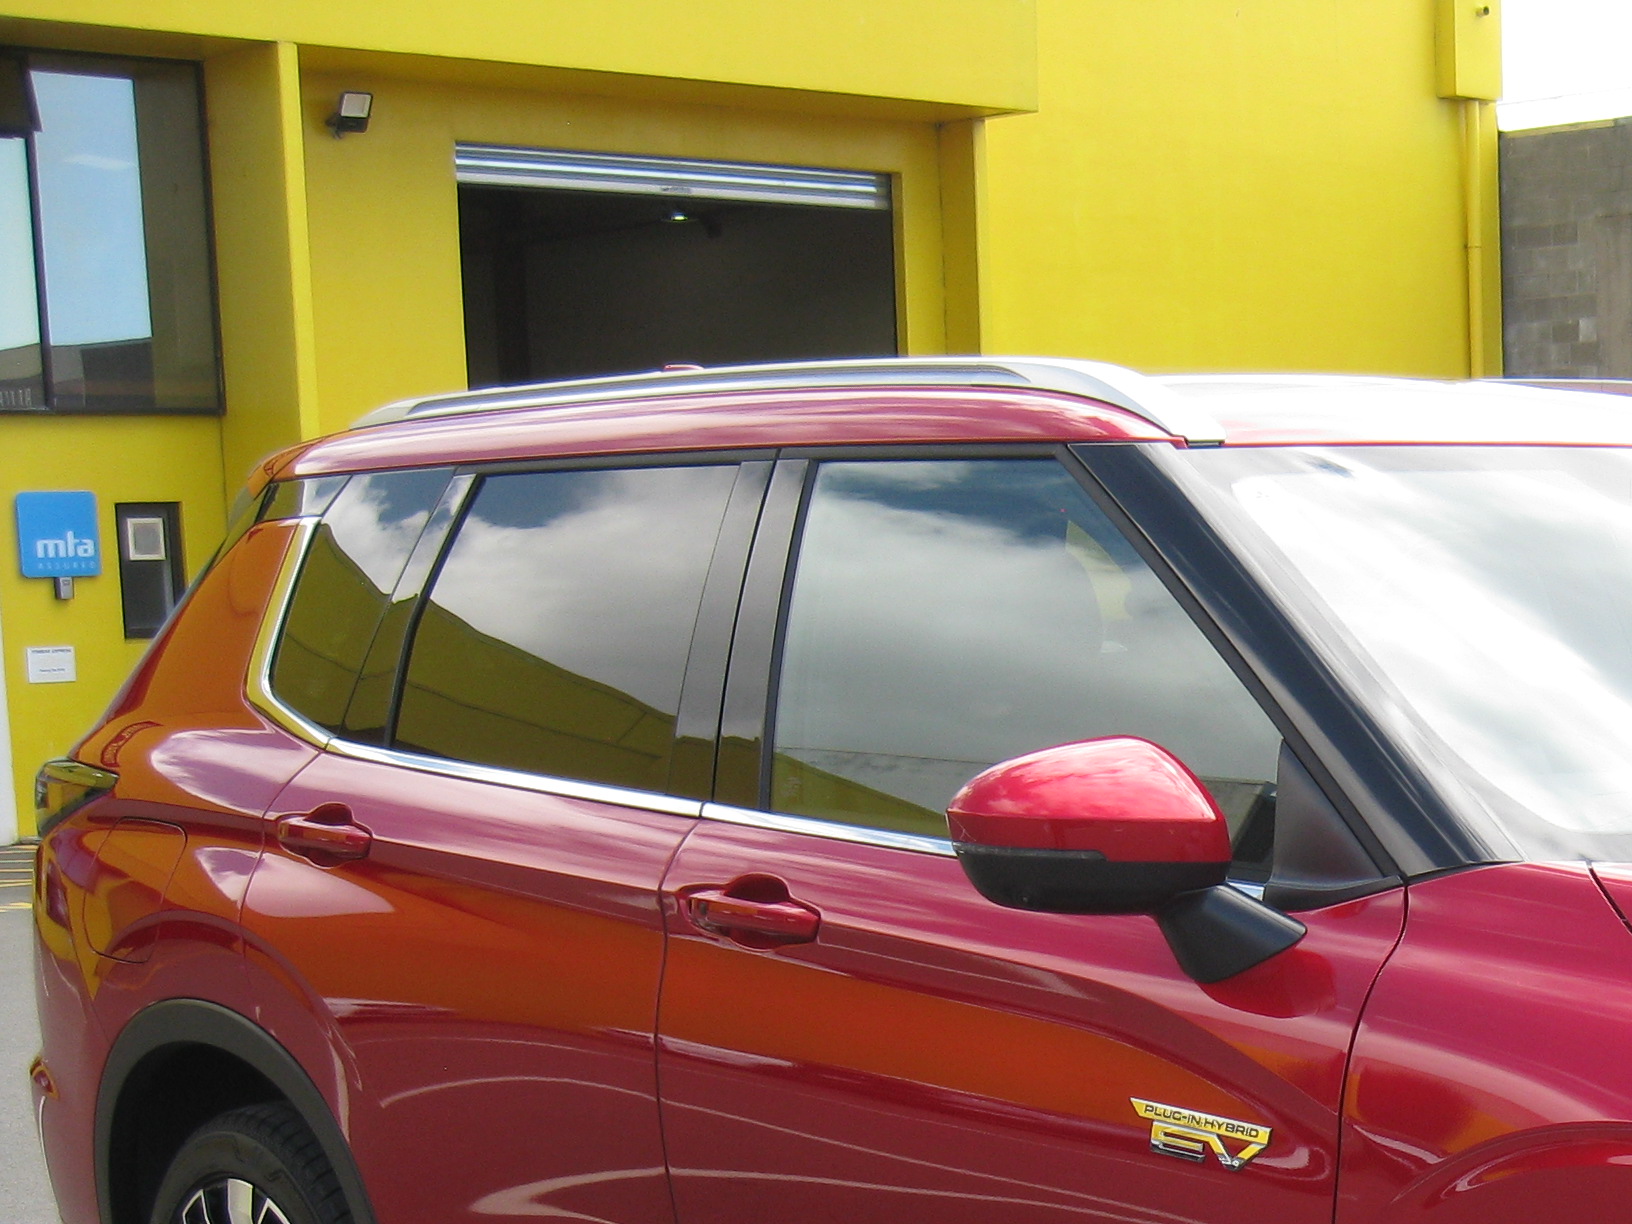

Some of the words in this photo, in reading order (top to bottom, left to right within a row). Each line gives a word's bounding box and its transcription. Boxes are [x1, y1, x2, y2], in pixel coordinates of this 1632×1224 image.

[36, 530, 95, 559] mta
[1143, 1104, 1201, 1125] PLUG-IN
[1203, 1118, 1260, 1139] HYBRID
[1150, 1119, 1267, 1172] EV
